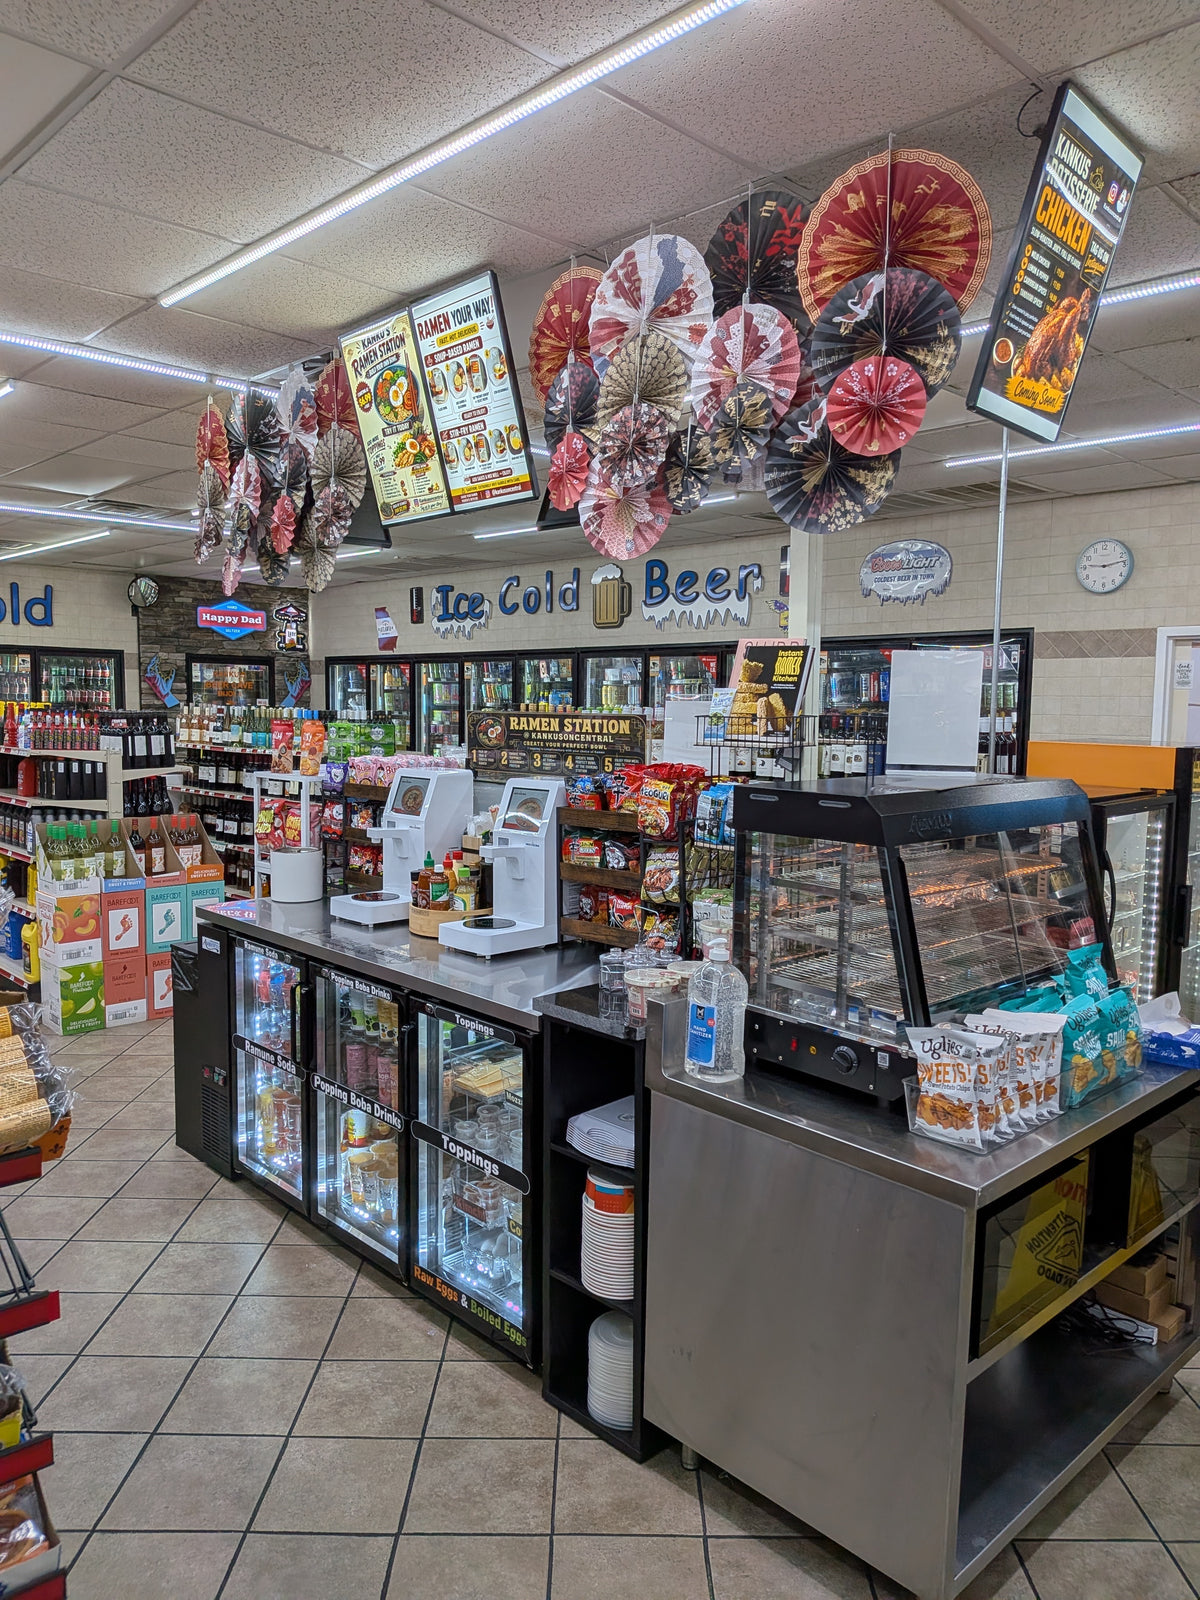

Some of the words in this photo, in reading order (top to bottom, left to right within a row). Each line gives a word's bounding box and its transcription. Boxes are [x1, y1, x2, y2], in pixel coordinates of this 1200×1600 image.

[1055, 133, 1092, 180] KANKUS
[1036, 185, 1092, 256] CHICKEN
[417, 311, 451, 341] RAMEN
[451, 304, 473, 327] YOUR
[472, 295, 494, 318] WAY!
[352, 345, 379, 379] RAMEN
[378, 332, 406, 357] STATION
[434, 346, 462, 362] SOUP-BASED
[463, 339, 480, 353] RAMEN
[1014, 380, 1039, 408] Coming
[1039, 388, 1061, 408] Soon!
[397, 423, 410, 433] TODAY
[449, 425, 468, 438] STIR-FRY
[469, 422, 485, 434] RAMEN
[367, 439, 386, 457] TOPPINGS
[871, 556, 902, 573] Coors
[902, 556, 940, 570] LIGHT
[644, 558, 762, 606] Beer
[0, 582, 54, 627] ld
[437, 584, 485, 623] Ice
[499, 566, 580, 616] Cold
[202, 613, 239, 625] Happy
[241, 615, 262, 624] Dad
[509, 716, 560, 732] RAMEN
[564, 718, 630, 734] STATION
[531, 732, 614, 743] KANKUSONCENTRAL
[472, 749, 476, 763] 1
[501, 751, 508, 765] 2
[533, 753, 541, 767] 3
[565, 755, 574, 769] 4
[604, 758, 612, 772] 5
[107, 897, 139, 906] BAREFOOT
[151, 891, 181, 900] BAREFOOT
[191, 888, 220, 897] BAREFOOT
[265, 949, 278, 960] Soda
[70, 980, 94, 989] BAREFOOT
[331, 973, 354, 989] Popping
[355, 980, 370, 993] Boba
[371, 986, 390, 1000] Drinks
[455, 1013, 494, 1036] Toppings
[1067, 1006, 1098, 1032] Uglies
[1109, 1004, 1128, 1028] Uglies
[244, 1040, 275, 1063] Ramune
[276, 1056, 296, 1074] Soda
[921, 1036, 963, 1060] Uglies
[918, 1062, 972, 1085] SWEETS!
[314, 1076, 348, 1104] Popping
[350, 1093, 372, 1113] Boba
[374, 1105, 401, 1130] Drinks
[442, 1134, 500, 1176] Toppings
[414, 1266, 434, 1286] Raw
[436, 1279, 459, 1302] Eggs
[460, 1294, 468, 1308] &
[470, 1300, 501, 1330] Boiled
[504, 1320, 528, 1347] Eggs
